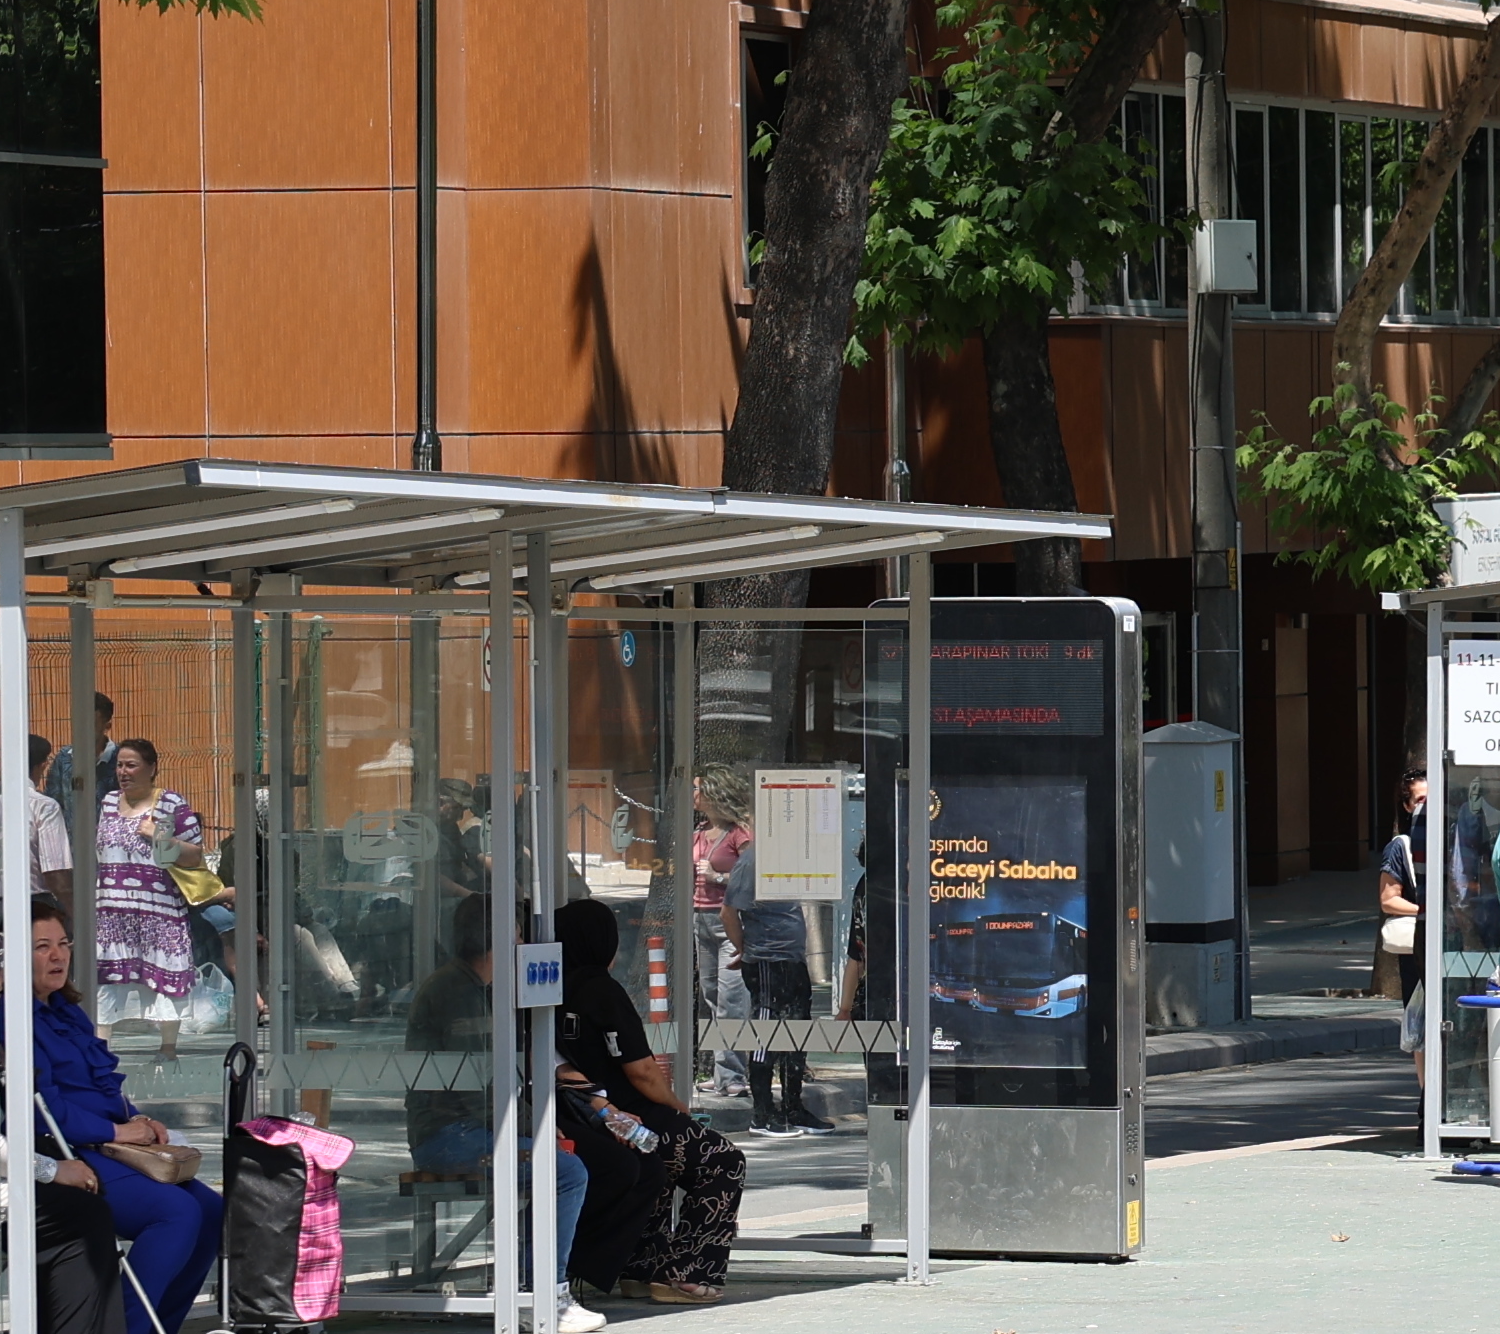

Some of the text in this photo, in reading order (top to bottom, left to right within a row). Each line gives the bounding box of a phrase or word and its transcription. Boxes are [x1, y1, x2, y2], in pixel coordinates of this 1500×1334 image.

[929, 645, 1010, 660] ARAPINAR
[1063, 645, 1073, 660] 9
[1076, 645, 1095, 660] dk
[953, 707, 1061, 727] AŞAMASINDA
[929, 835, 989, 855] aşımda
[931, 858, 1077, 884] Geceyi Sabaha
[929, 880, 986, 903] ğladık!
